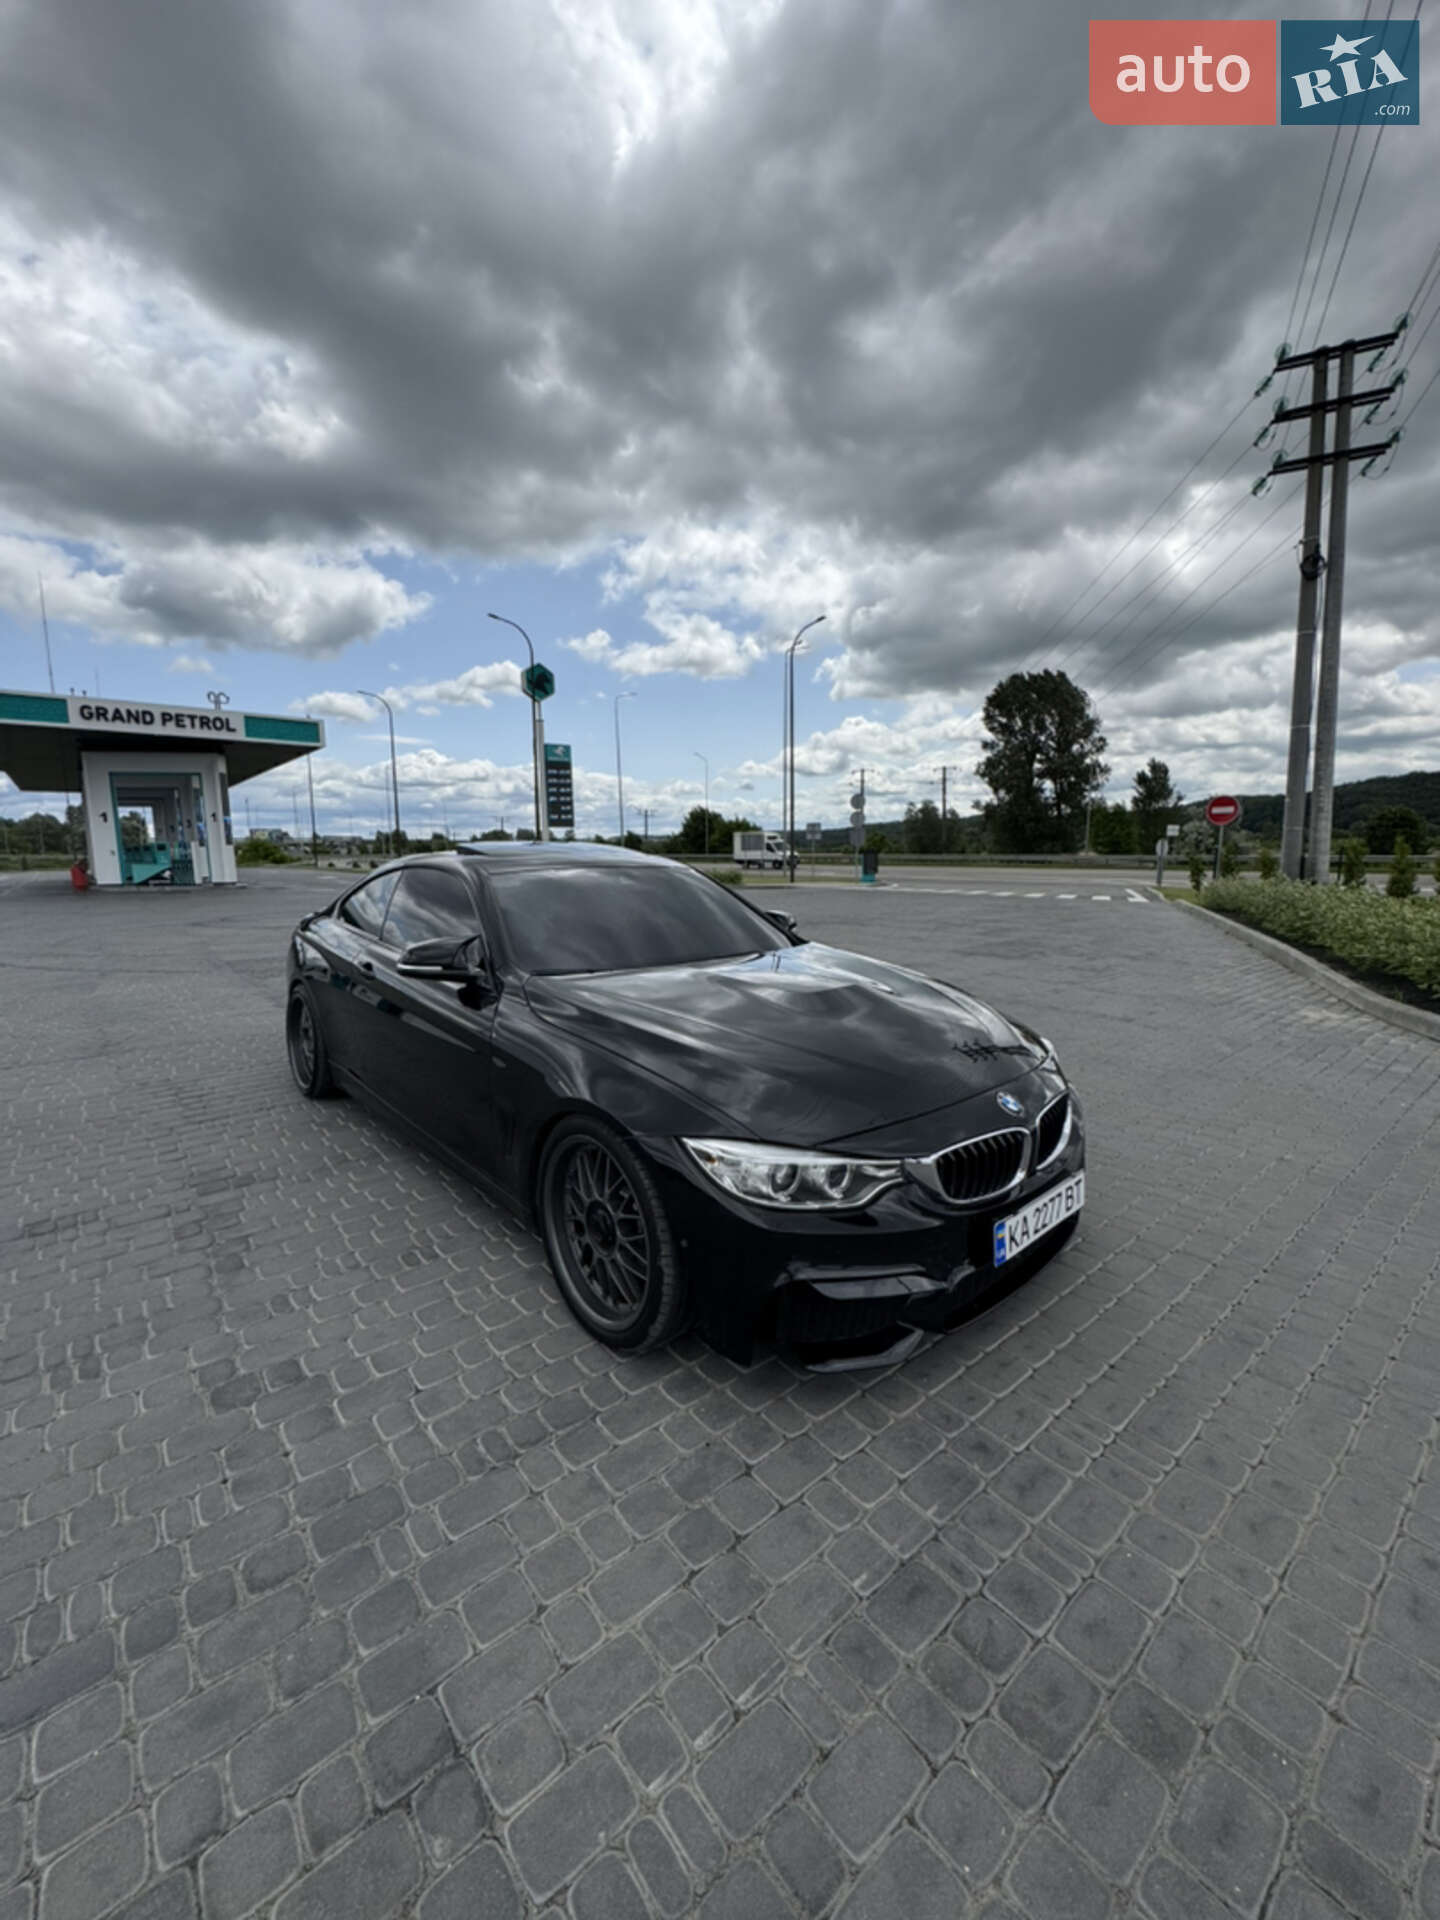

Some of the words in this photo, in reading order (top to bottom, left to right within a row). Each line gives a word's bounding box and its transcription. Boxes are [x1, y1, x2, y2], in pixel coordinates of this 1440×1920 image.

[79, 704, 155, 726] GRAND
[161, 712, 237, 733] PETROL
[1008, 1215, 1030, 1253] KA
[1033, 1192, 1063, 1235] 2277
[1065, 1178, 1083, 1212] BT
